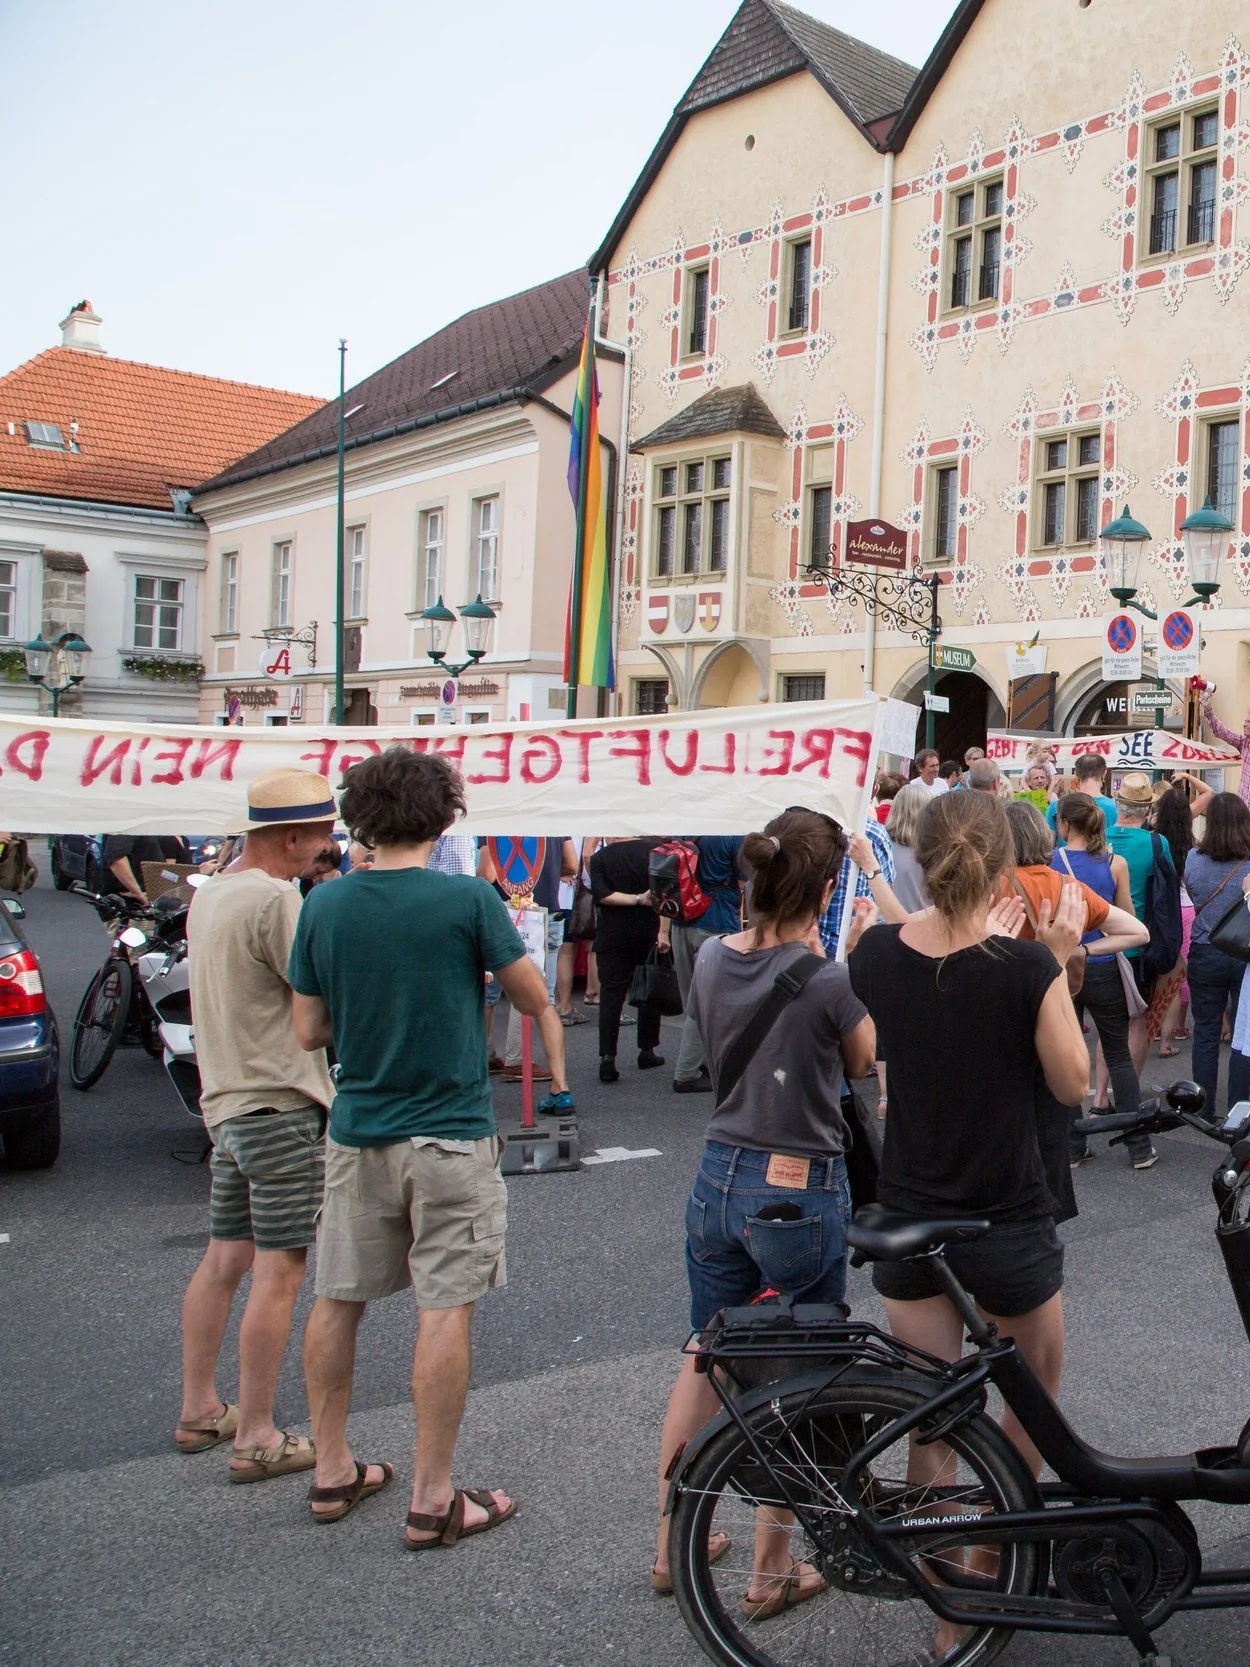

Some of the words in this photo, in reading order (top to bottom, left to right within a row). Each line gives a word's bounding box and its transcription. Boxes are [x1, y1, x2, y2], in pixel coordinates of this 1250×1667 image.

[849, 534, 904, 555] alexander
[943, 650, 971, 667] MUSEUM
[1136, 694, 1172, 705] Parkscheine
[1119, 731, 1154, 757] SEE
[501, 876, 534, 895] ANFANG
[902, 1517, 940, 1527] URBAN
[942, 1513, 982, 1524] ARROW
